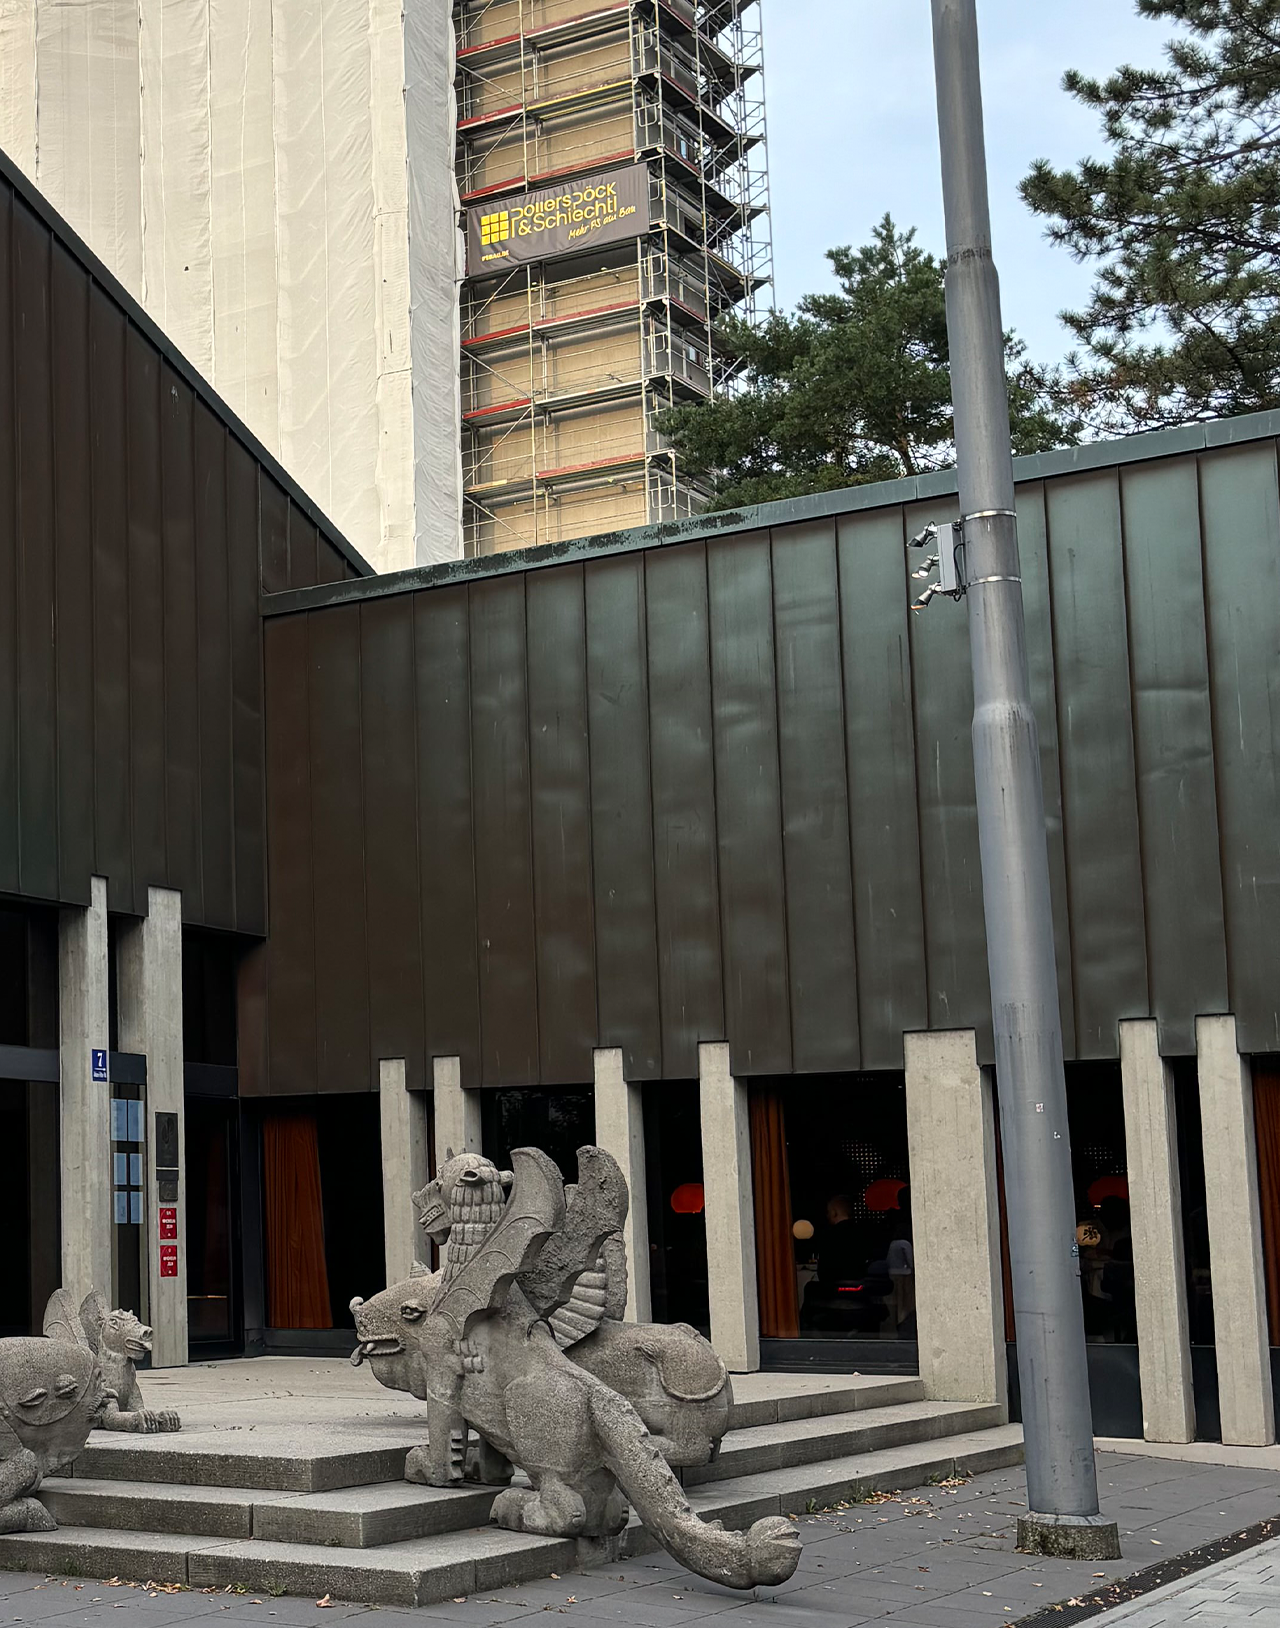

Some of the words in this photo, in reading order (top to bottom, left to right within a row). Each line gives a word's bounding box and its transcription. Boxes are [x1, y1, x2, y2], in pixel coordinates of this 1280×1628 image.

[518, 219, 532, 236] &
[533, 195, 617, 232] Schiechtl
[619, 205, 636, 218] Bau
[97, 1052, 103, 1067] 7
